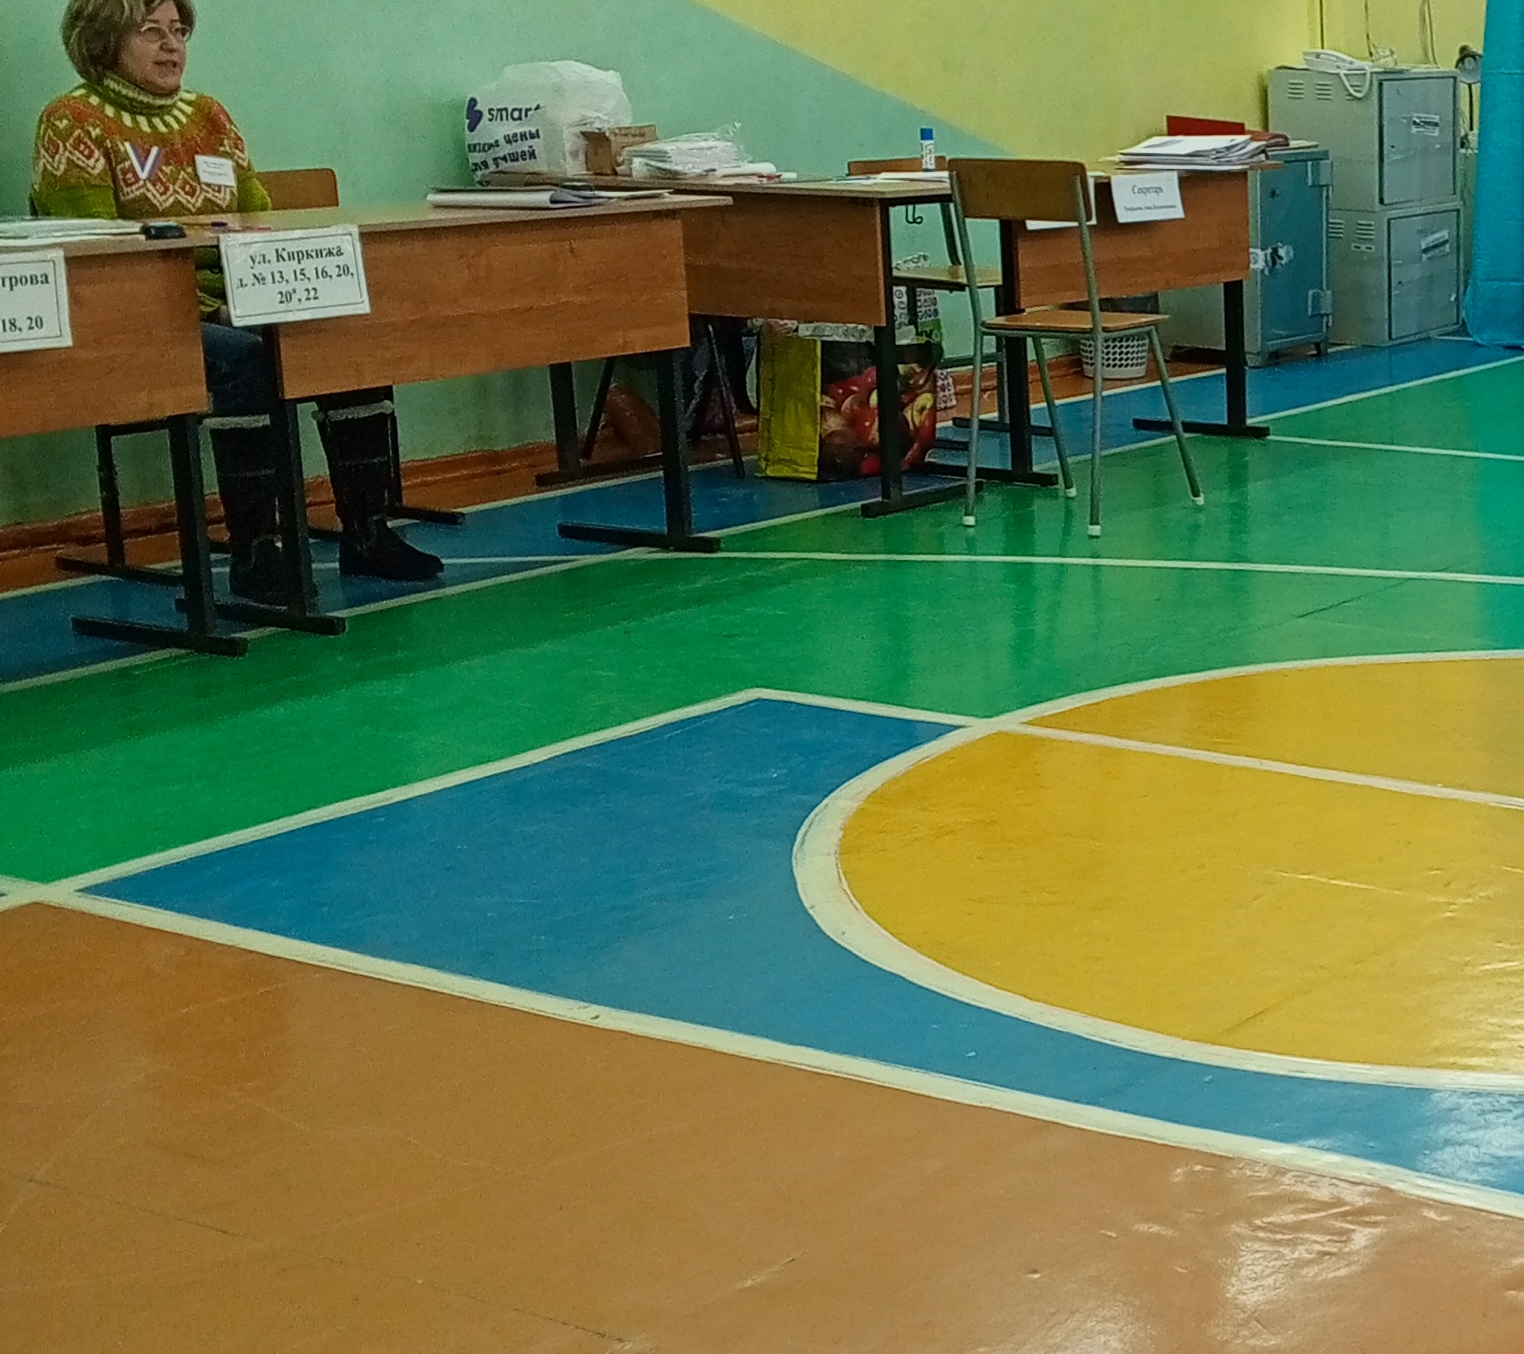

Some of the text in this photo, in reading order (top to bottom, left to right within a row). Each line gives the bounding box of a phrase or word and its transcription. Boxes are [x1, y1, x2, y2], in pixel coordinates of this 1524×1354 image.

[503, 128, 540, 145] цены
[249, 245, 345, 269] ул. Киркижа
[251, 272, 267, 286] №
[270, 270, 290, 285] 13,
[293, 268, 311, 283] 15,
[314, 266, 333, 281] 16,
[335, 263, 355, 277] 20,
[304, 287, 319, 301] 22
[1, 314, 44, 333] 18, 20
